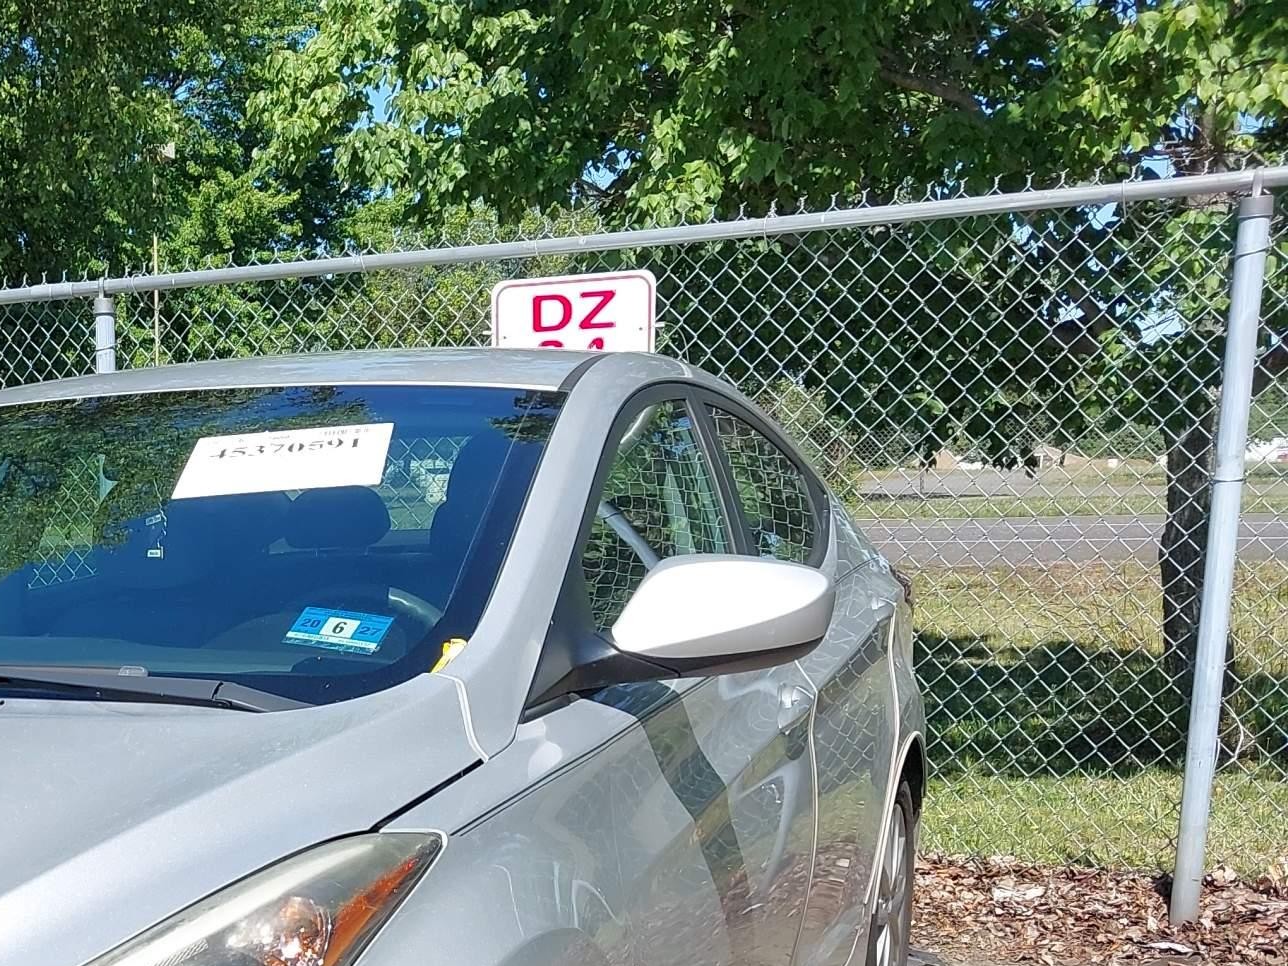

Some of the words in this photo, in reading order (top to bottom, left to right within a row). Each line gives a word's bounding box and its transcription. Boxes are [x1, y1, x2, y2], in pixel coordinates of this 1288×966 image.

[532, 289, 616, 333] DZ
[301, 618, 322, 628] 20
[332, 621, 348, 635] 6
[358, 626, 383, 637] 27
